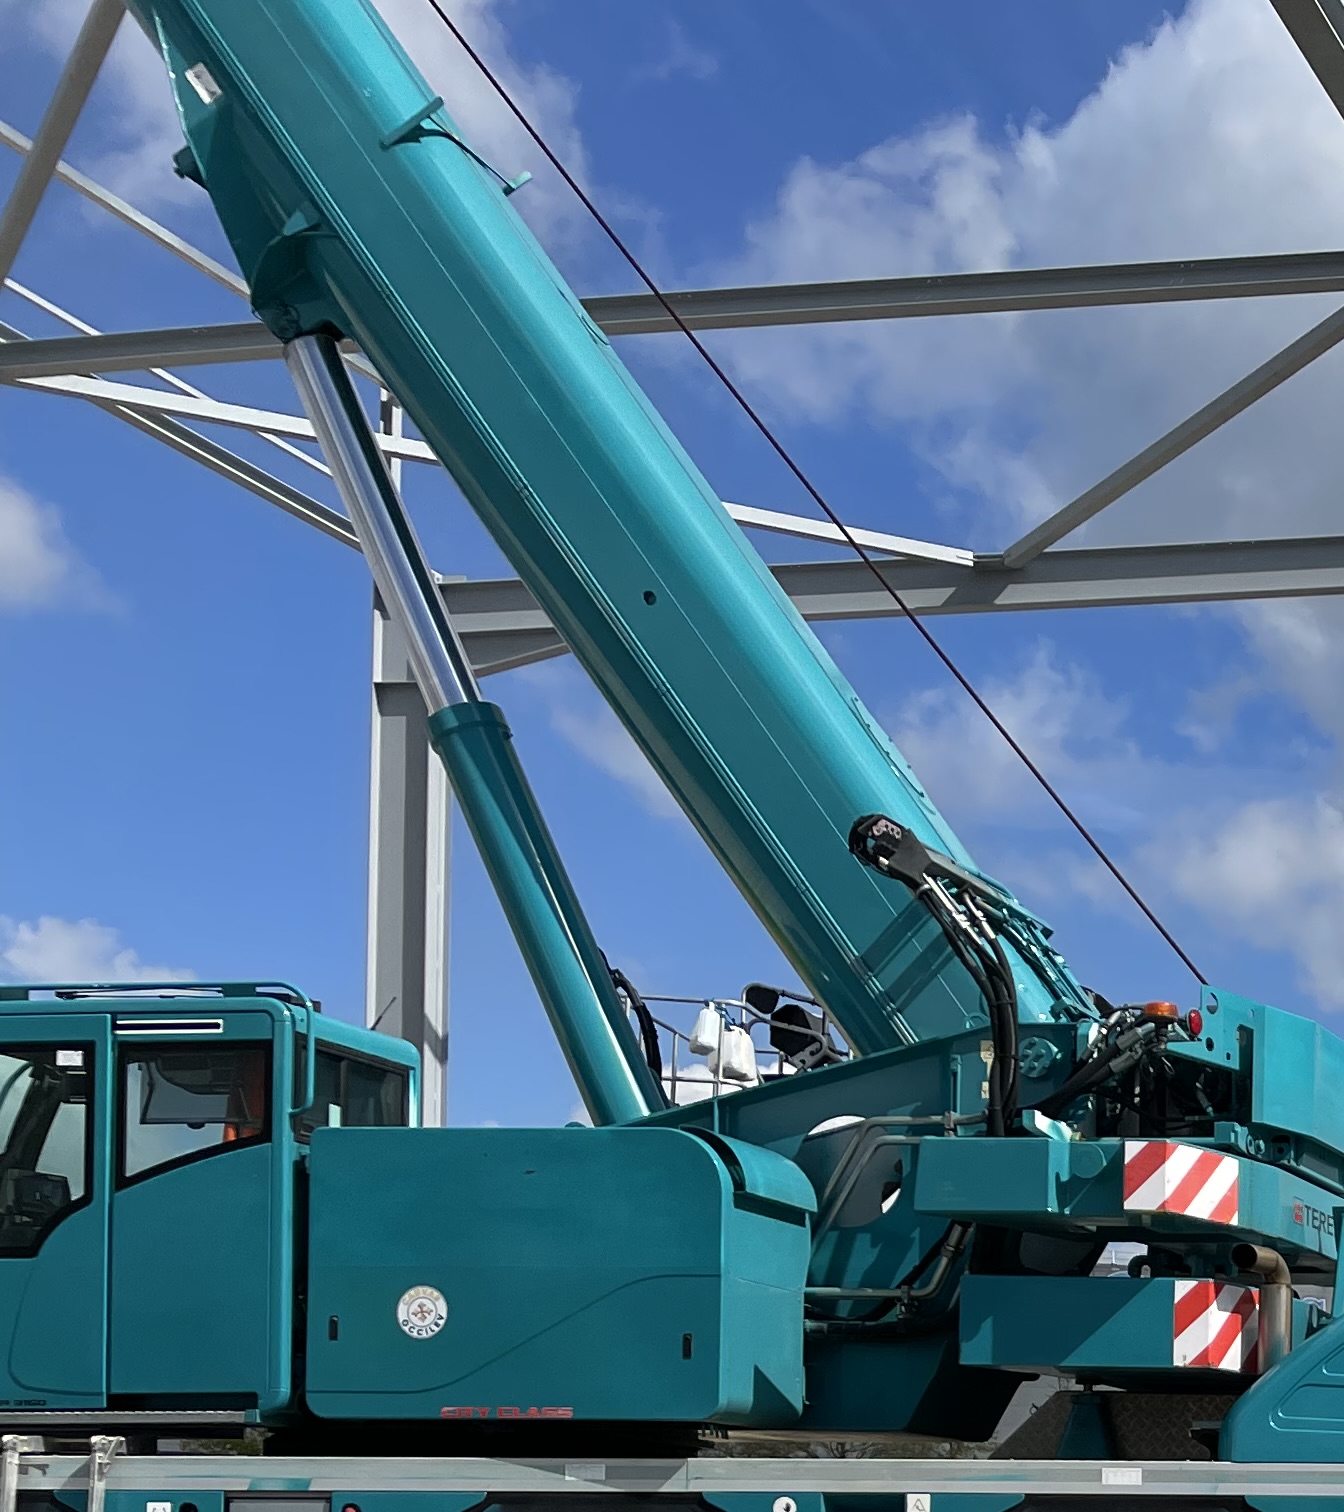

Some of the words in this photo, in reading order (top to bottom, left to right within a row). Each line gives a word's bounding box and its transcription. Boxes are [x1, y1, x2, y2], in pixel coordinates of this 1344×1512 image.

[1305, 1205, 1334, 1236] TERE
[402, 1314, 444, 1336] OCCILEV
[440, 1406, 491, 1418] CITY
[497, 1406, 574, 1418] CLASS
